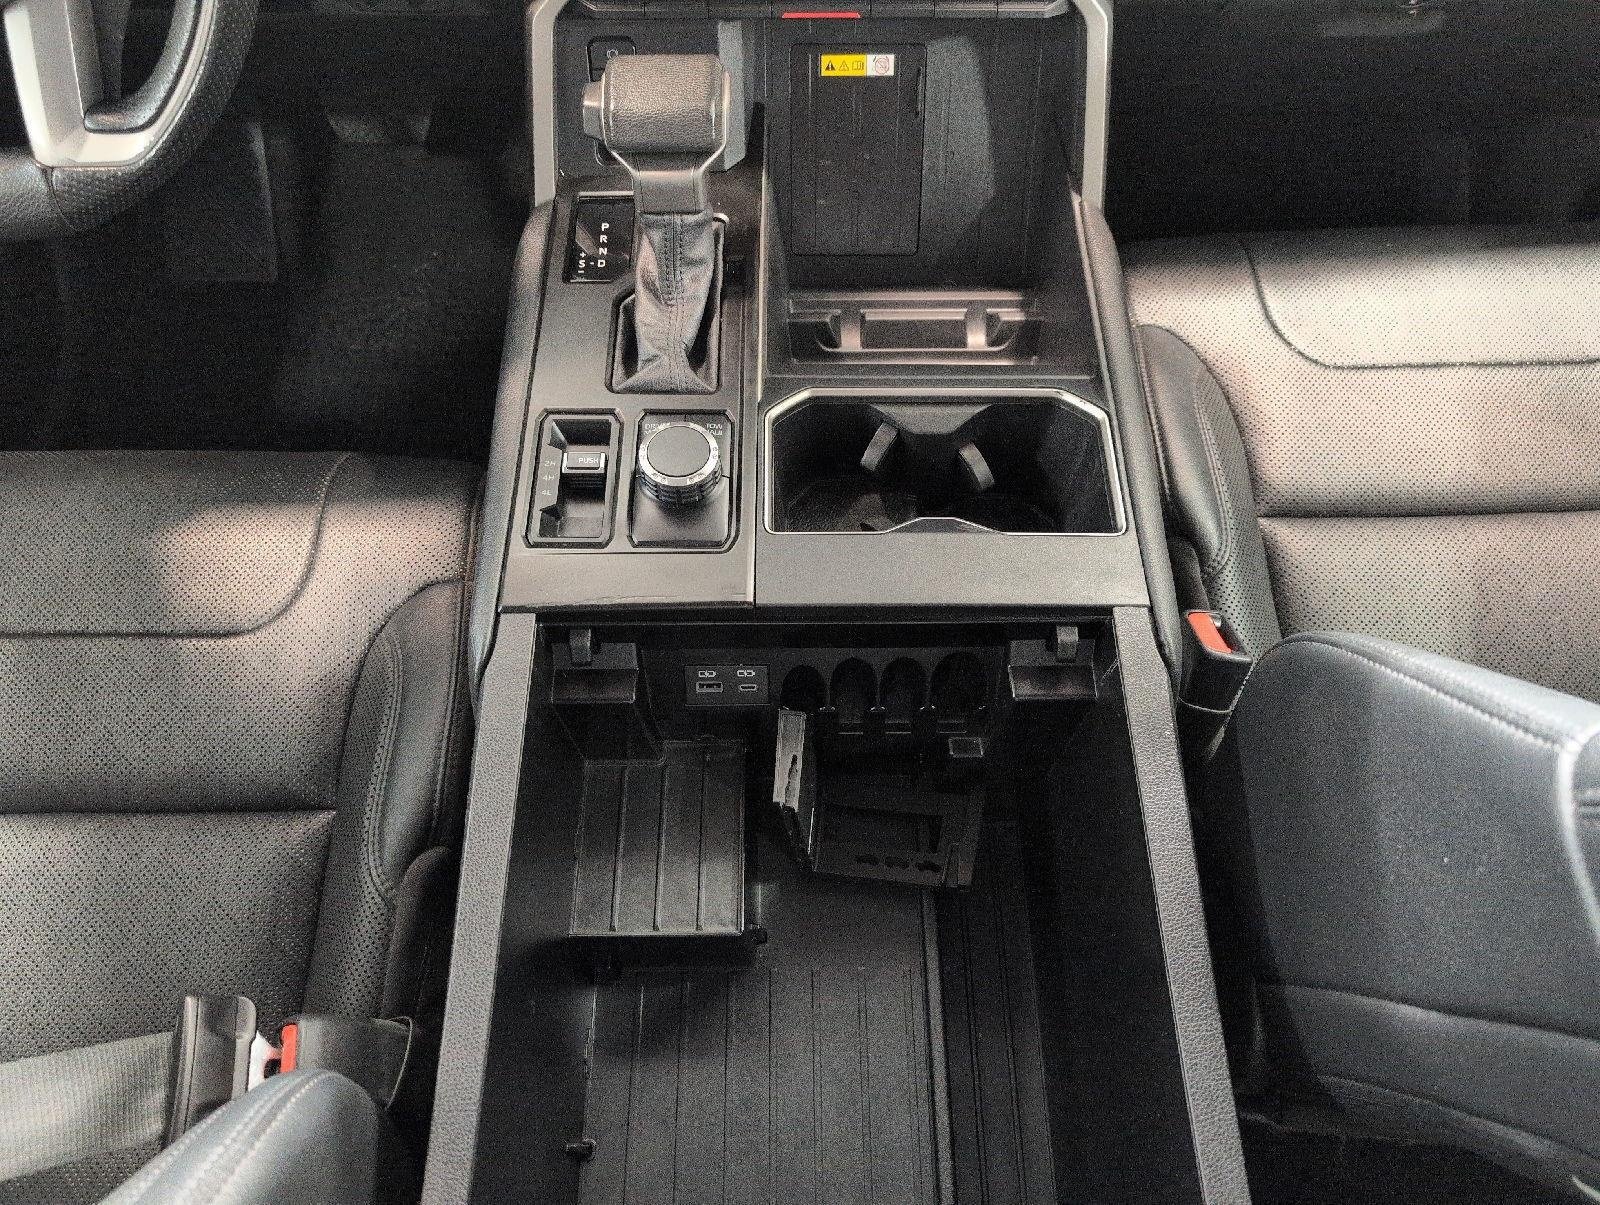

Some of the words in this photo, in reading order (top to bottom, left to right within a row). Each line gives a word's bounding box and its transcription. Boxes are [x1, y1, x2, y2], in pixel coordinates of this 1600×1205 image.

[601, 222, 609, 231] P
[600, 235, 607, 243] R
[599, 247, 607, 255] N
